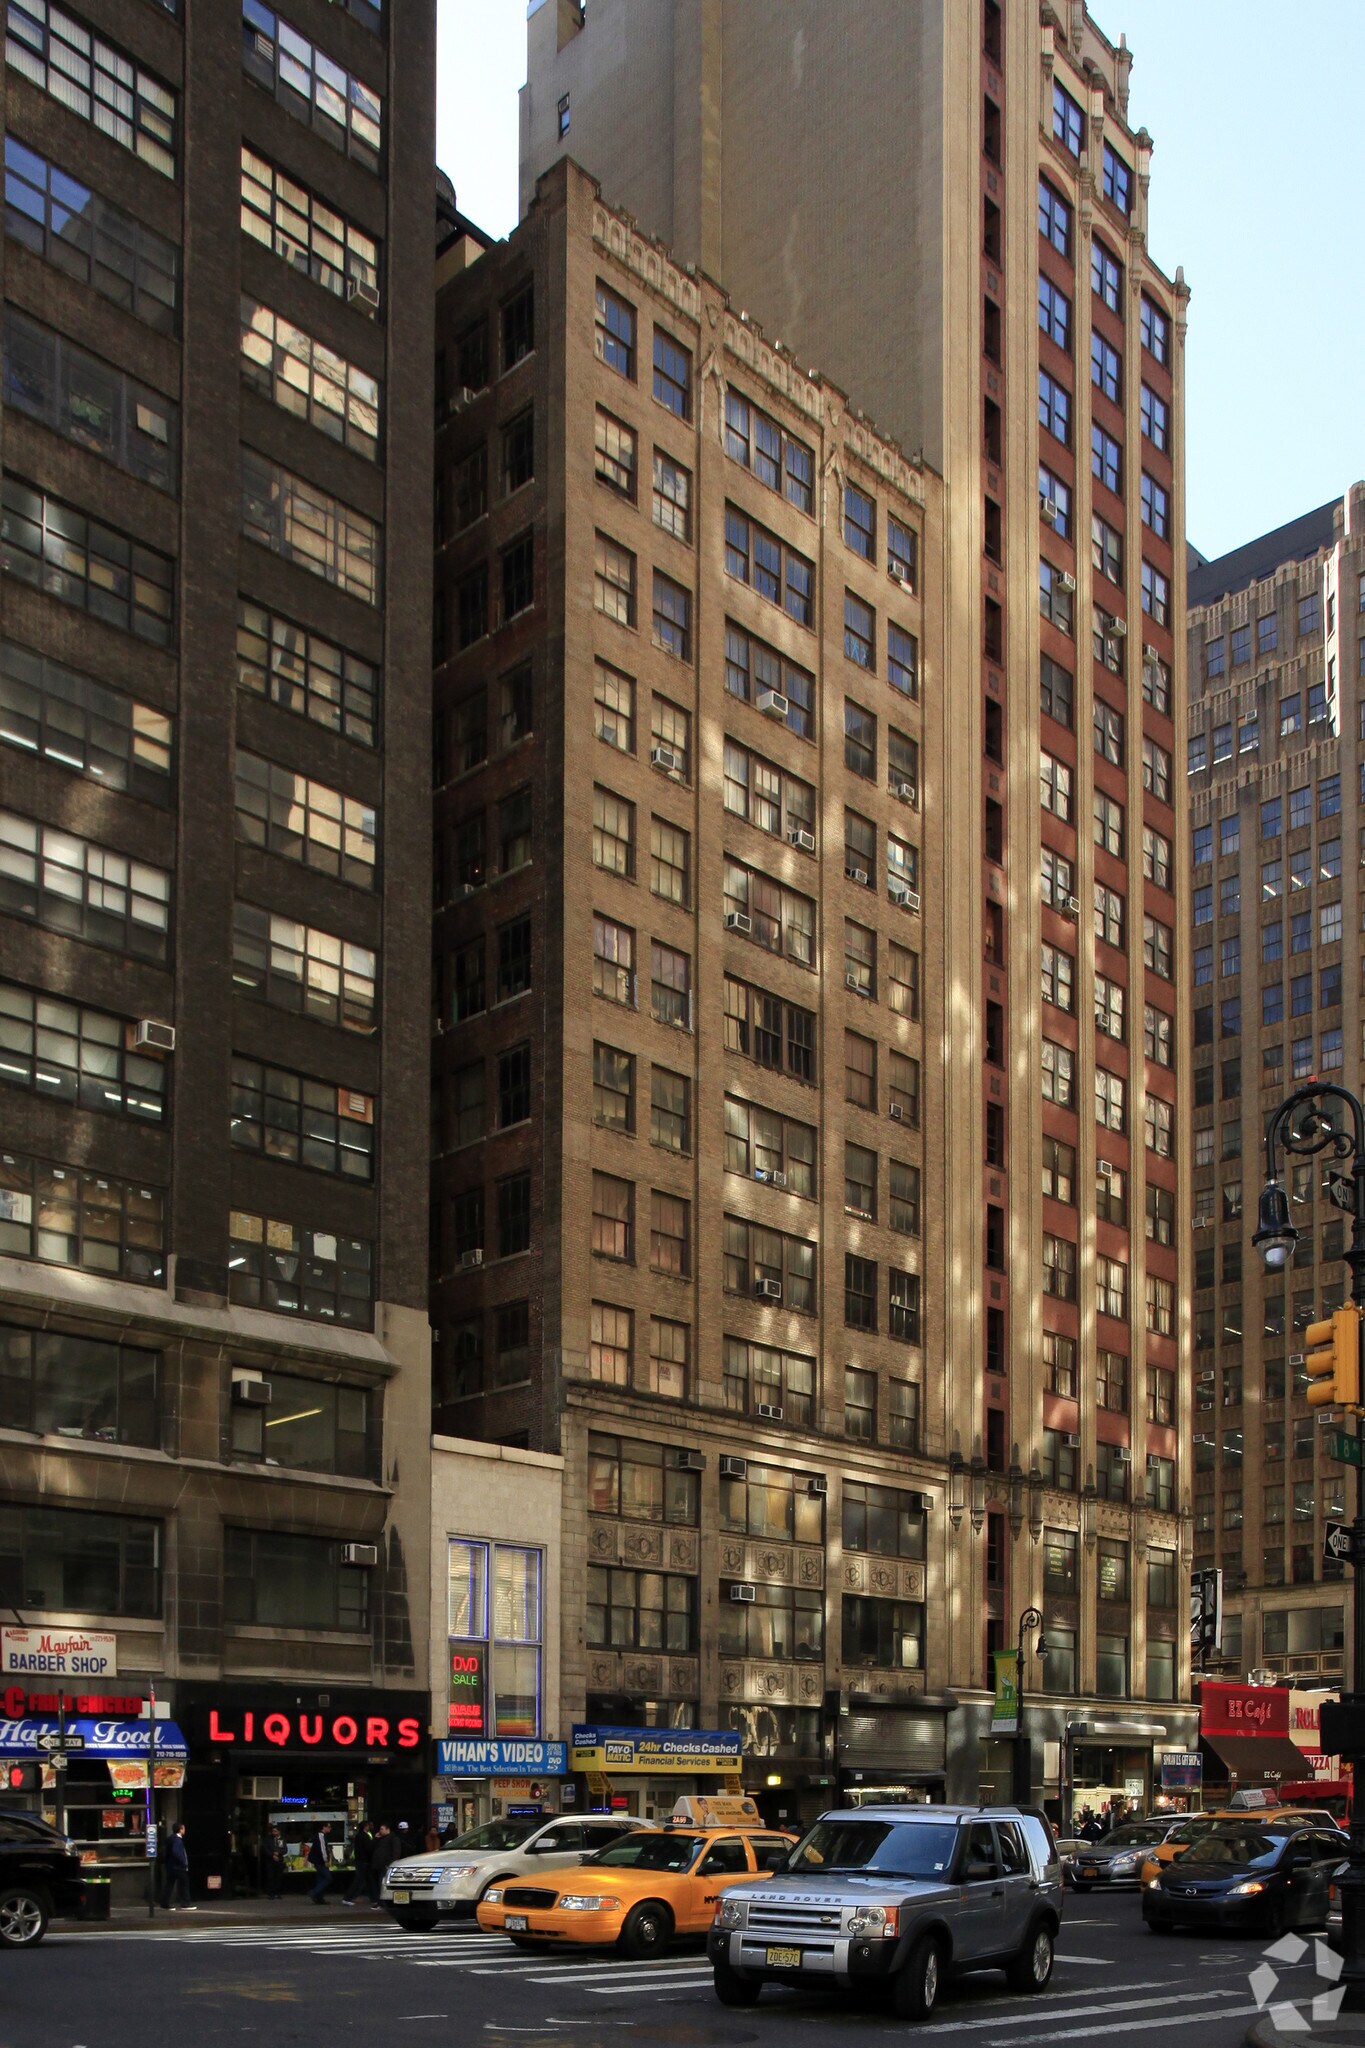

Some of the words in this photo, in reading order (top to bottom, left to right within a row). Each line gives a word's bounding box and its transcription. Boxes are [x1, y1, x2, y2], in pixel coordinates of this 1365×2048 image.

[1333, 1534, 1347, 1550] ONE
[36, 1634, 93, 1656] Mayfair
[9, 1652, 66, 1672] BARBER
[71, 1656, 108, 1674] SHOP
[453, 1656, 479, 1672] DVD
[453, 1674, 478, 1686] SALE
[77, 1695, 143, 1714] CHICKEN
[1228, 1700, 1243, 1718] EZ
[92, 1721, 165, 1744] Food
[209, 1710, 420, 1748] LIQUORS
[442, 1742, 499, 1762] VIHAN'S
[502, 1743, 544, 1763] VIDEO
[639, 1741, 661, 1752] 24hr
[663, 1742, 701, 1754] Checks
[701, 1743, 738, 1754] Cashed
[548, 1757, 562, 1765] DVD
[606, 1754, 632, 1762] MATIC
[639, 1756, 675, 1766] Financial
[676, 1757, 711, 1766] Services
[480, 1765, 492, 1773] Best
[493, 1765, 519, 1773] Selection
[1264, 1771, 1271, 1779] EZ
[494, 1779, 510, 1788] PEEP
[511, 1779, 531, 1788] SHOW
[112, 1789, 133, 1798] PIZZA
[752, 1893, 787, 1901] LAND
